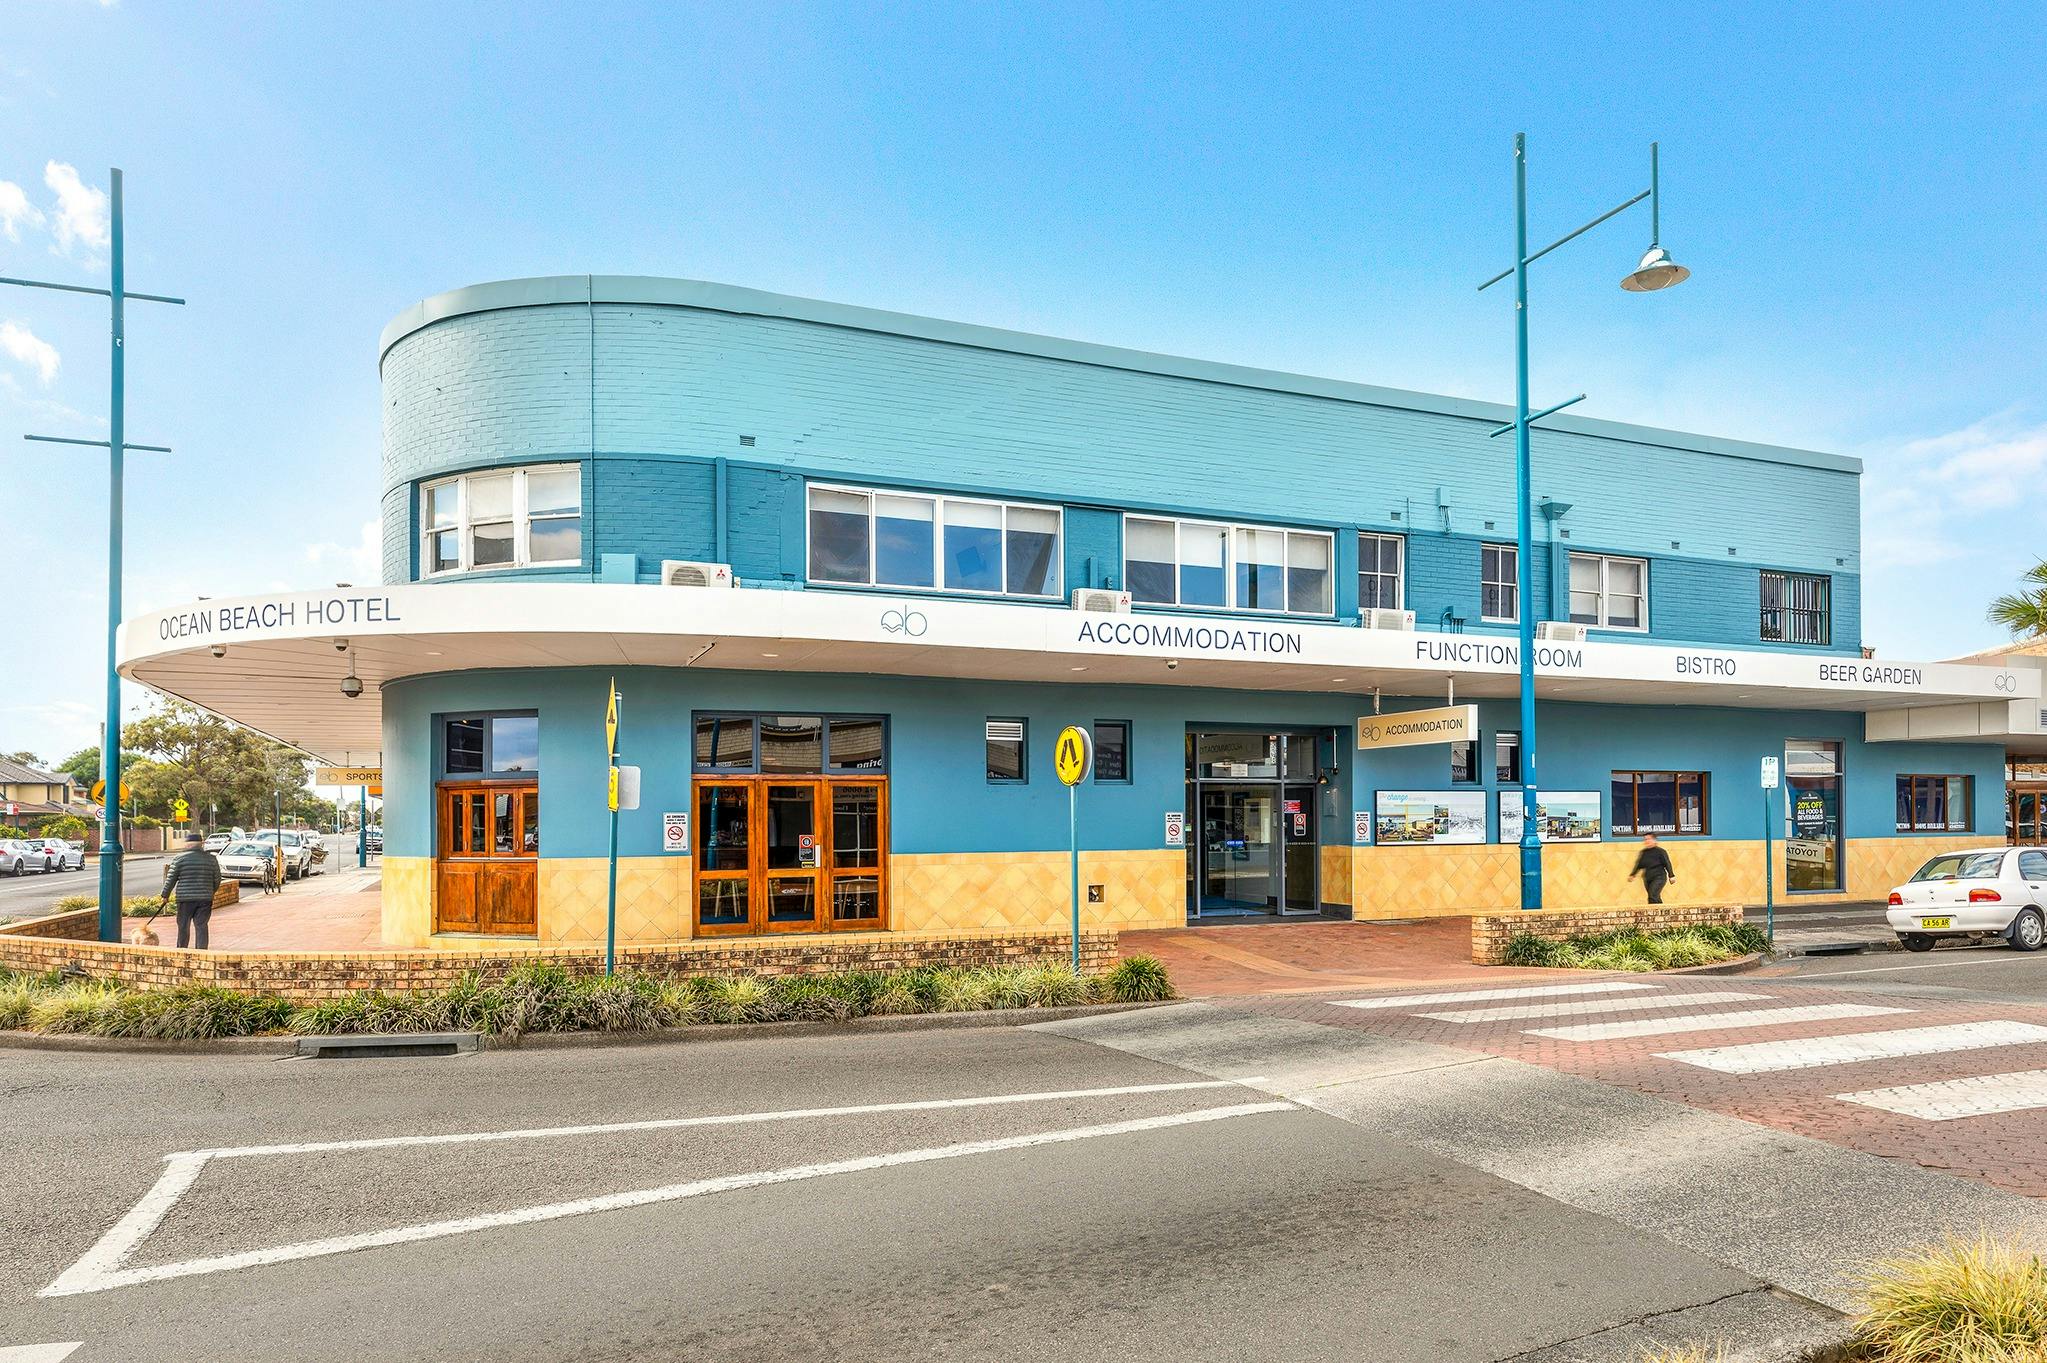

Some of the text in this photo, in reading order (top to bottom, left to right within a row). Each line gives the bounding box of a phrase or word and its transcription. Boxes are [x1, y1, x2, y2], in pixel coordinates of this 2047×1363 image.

[160, 598, 401, 640] OCEAN BEACH HOTEL
[1078, 621, 1300, 654] ACCOMMODATION
[1416, 641, 1518, 665] FUNCTION
[1676, 656, 1736, 676] BISTRO
[1820, 664, 1922, 685] BEER GARDEN
[1386, 719, 1463, 736] ACCOMMODATION
[1387, 793, 1408, 802] change
